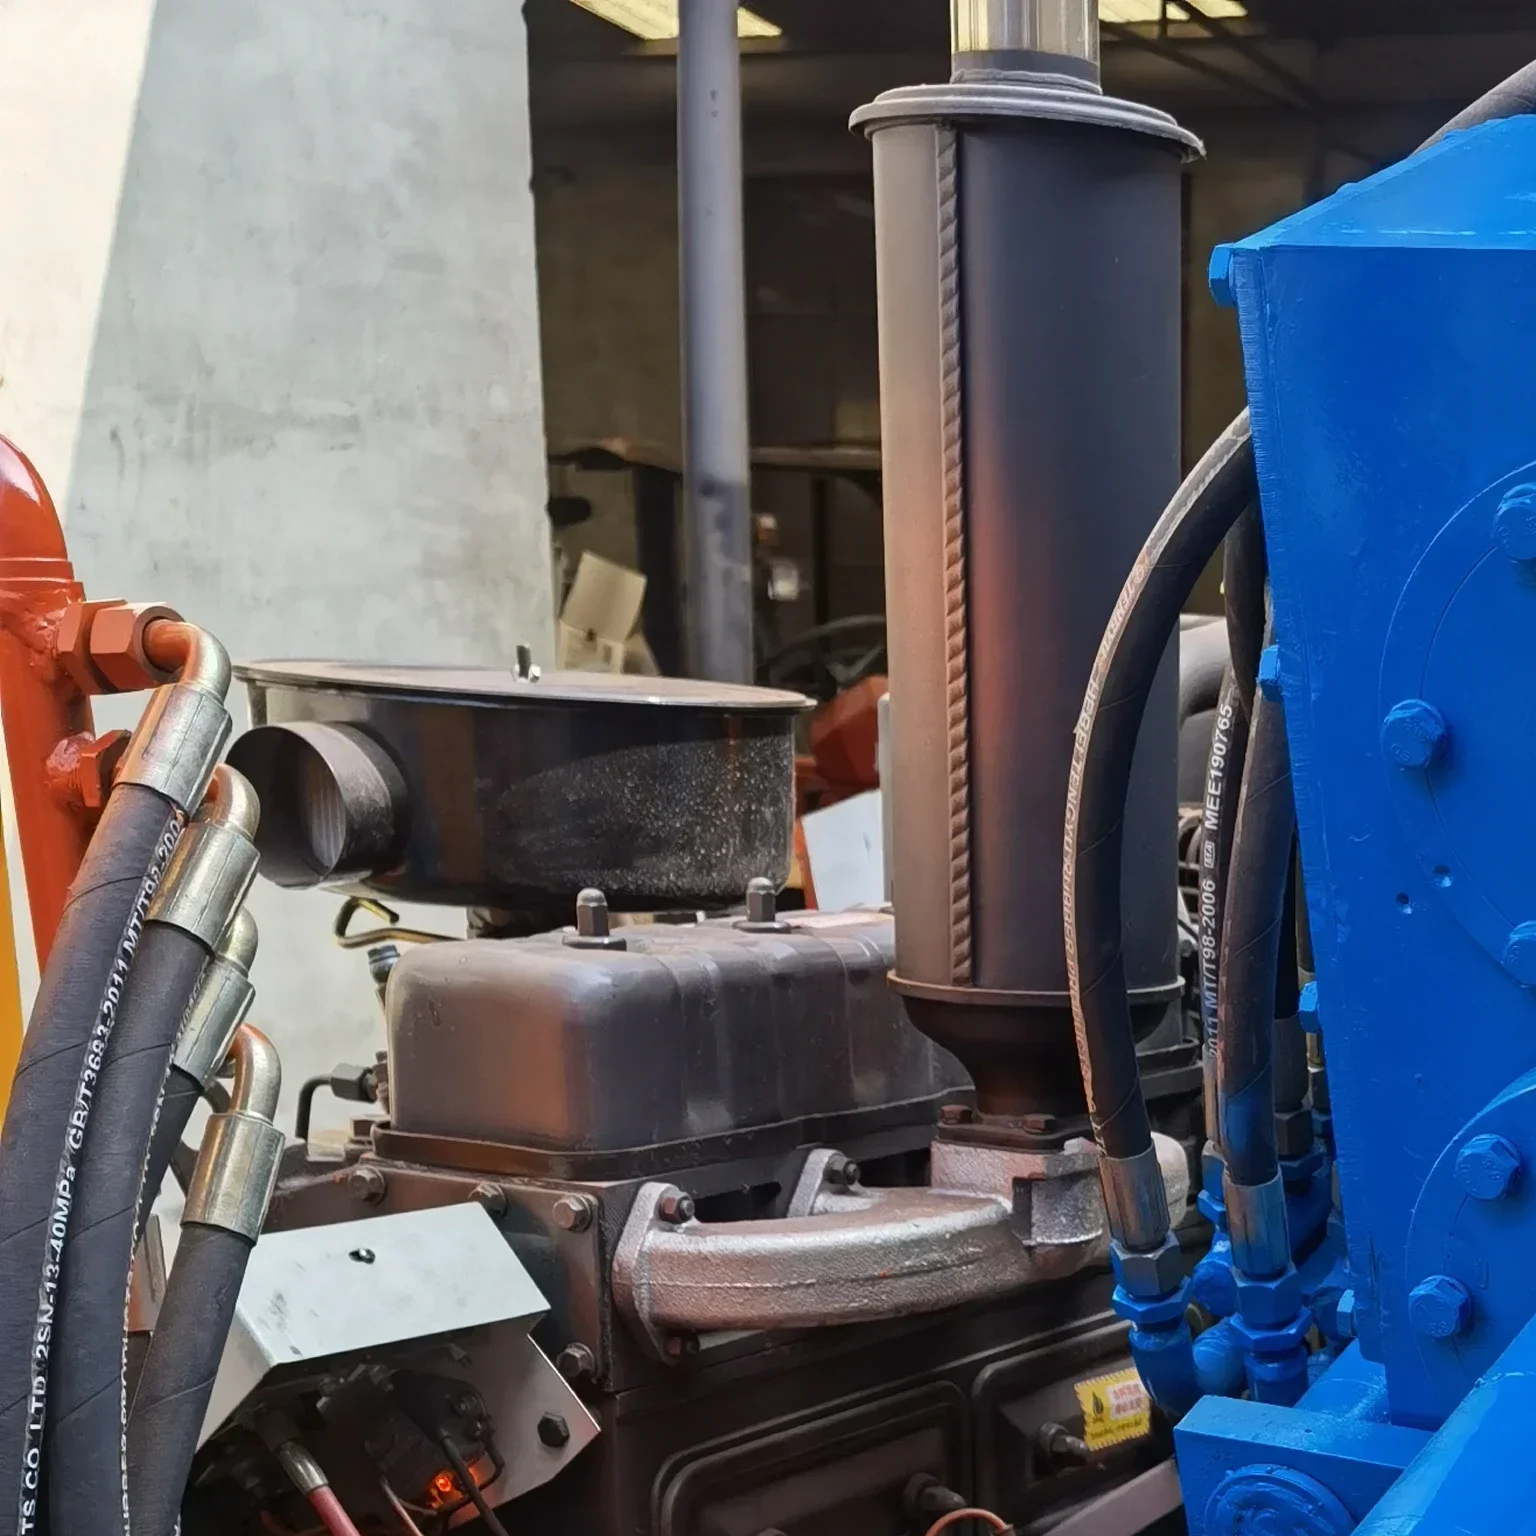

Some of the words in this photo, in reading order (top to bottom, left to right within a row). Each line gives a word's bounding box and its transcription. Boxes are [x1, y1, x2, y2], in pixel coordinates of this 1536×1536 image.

[1203, 703, 1234, 831] MEE190765
[1202, 879, 1219, 1010] MT/T98-2006
[67, 958, 128, 1150] GB/T3683-2011
[36, 1165, 76, 1358] 2SN-13-40MPa
[30, 1375, 46, 1430] LTD
[25, 1447, 40, 1490] CO
